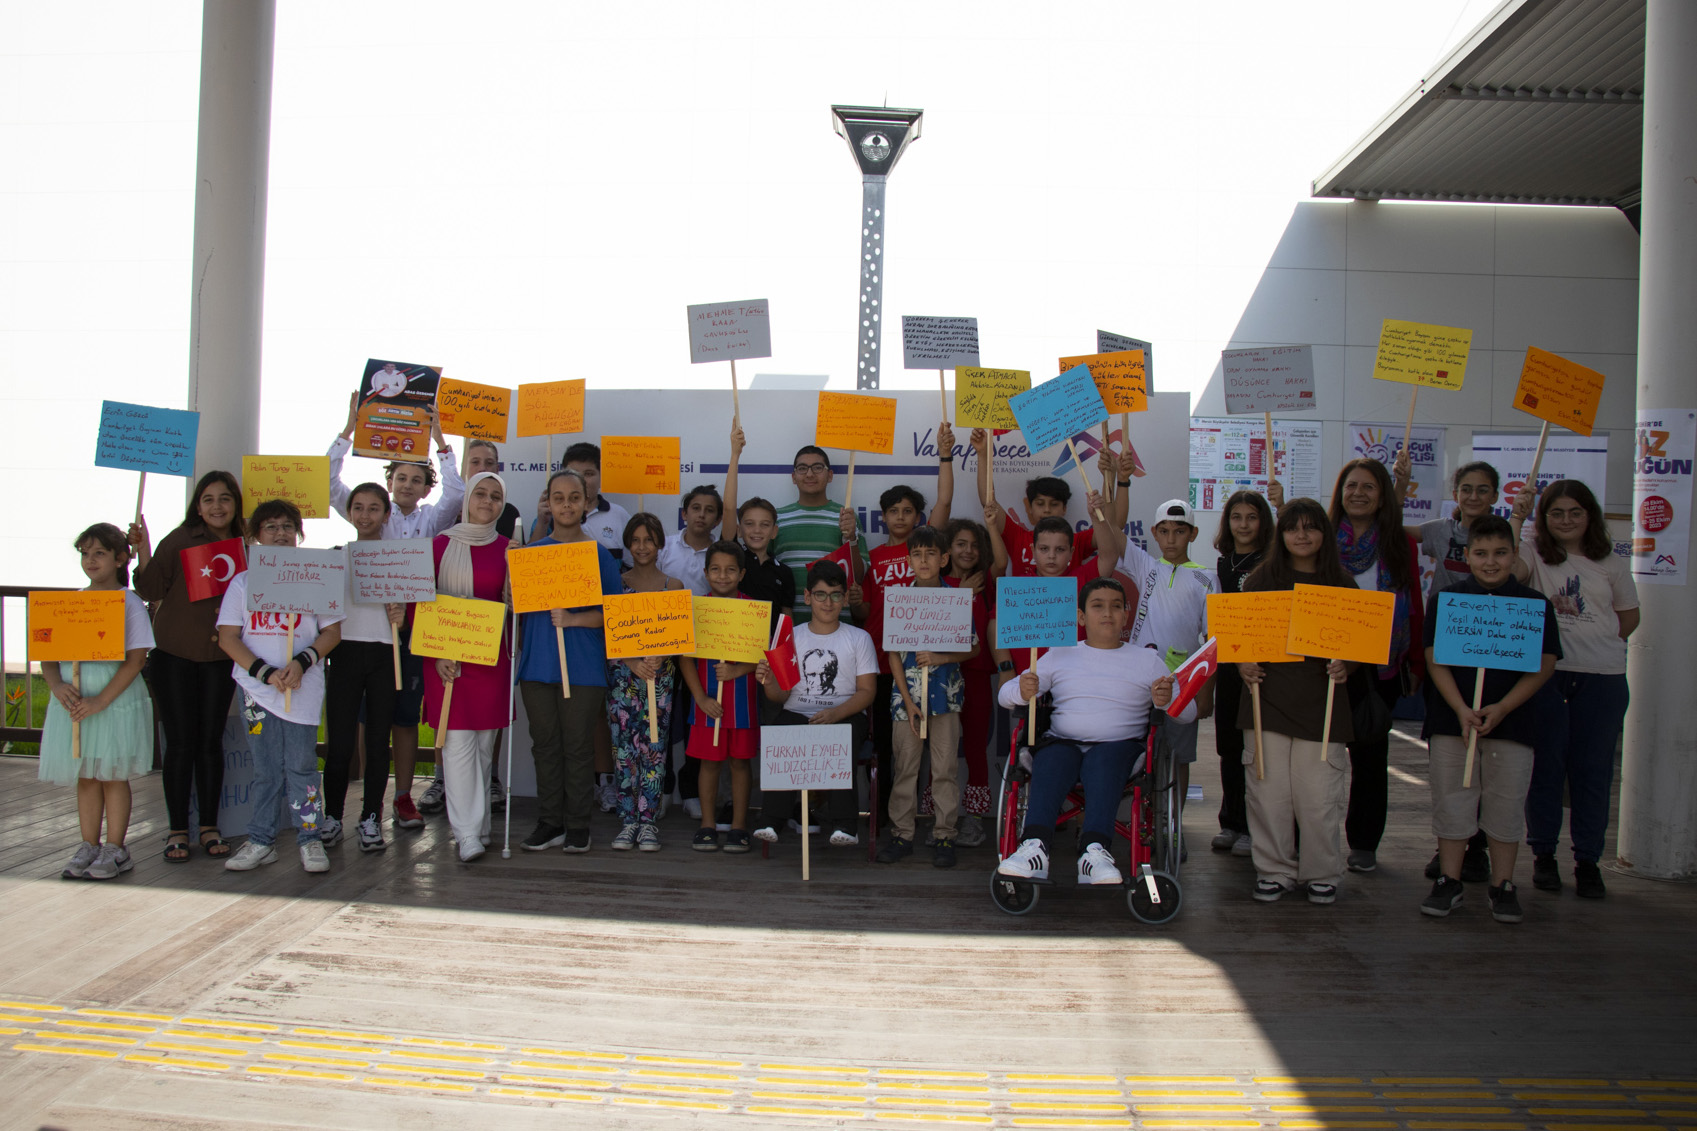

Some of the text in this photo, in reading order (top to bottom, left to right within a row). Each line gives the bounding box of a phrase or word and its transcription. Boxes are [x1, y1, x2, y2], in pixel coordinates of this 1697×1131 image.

[510, 462, 527, 472] T.C.
[1448, 611, 1468, 625] Yeşil
[903, 622, 970, 635] Aydınlanıyor
[1487, 629, 1506, 639] Daha
[887, 633, 953, 647] Tunay Berkin
[1462, 642, 1525, 659] Güzelleşecek
[765, 743, 849, 759] FURKAN EYMEN
